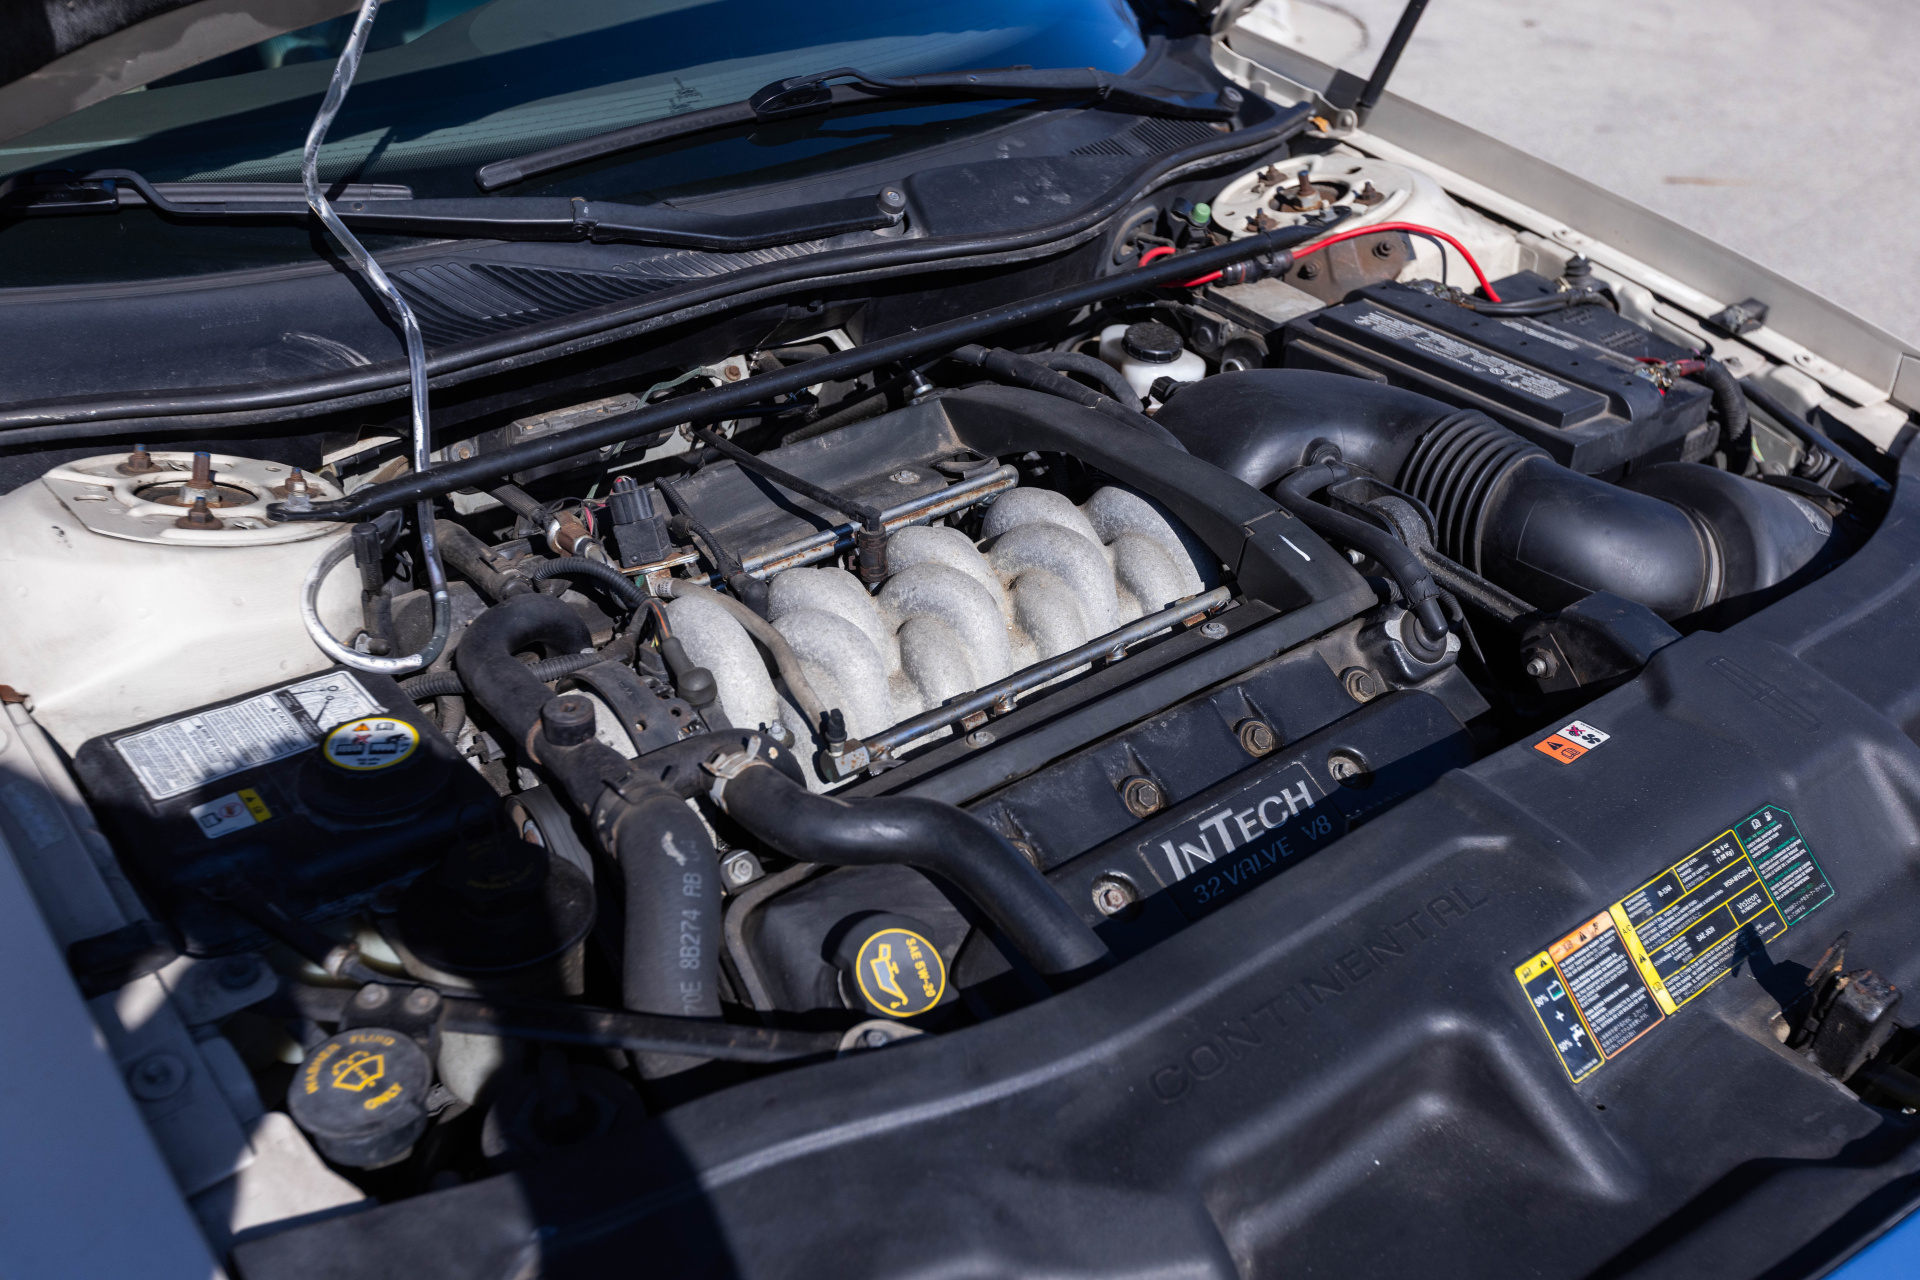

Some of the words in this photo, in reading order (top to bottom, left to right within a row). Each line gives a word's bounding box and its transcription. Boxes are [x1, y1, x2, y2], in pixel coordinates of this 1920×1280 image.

[1193, 876, 1225, 905] 32
[1224, 836, 1295, 886] VALVE
[1302, 814, 1333, 842] V8
[683, 871, 703, 898] AB
[1737, 892, 1758, 909] Visteon
[679, 909, 703, 971] 8B274
[905, 938, 922, 962] SAE
[915, 960, 936, 999] 5W-20
[1148, 886, 1490, 1105] CONTINENTAL
[1534, 993, 1549, 1008] 50%
[1558, 1038, 1573, 1053] 50%
